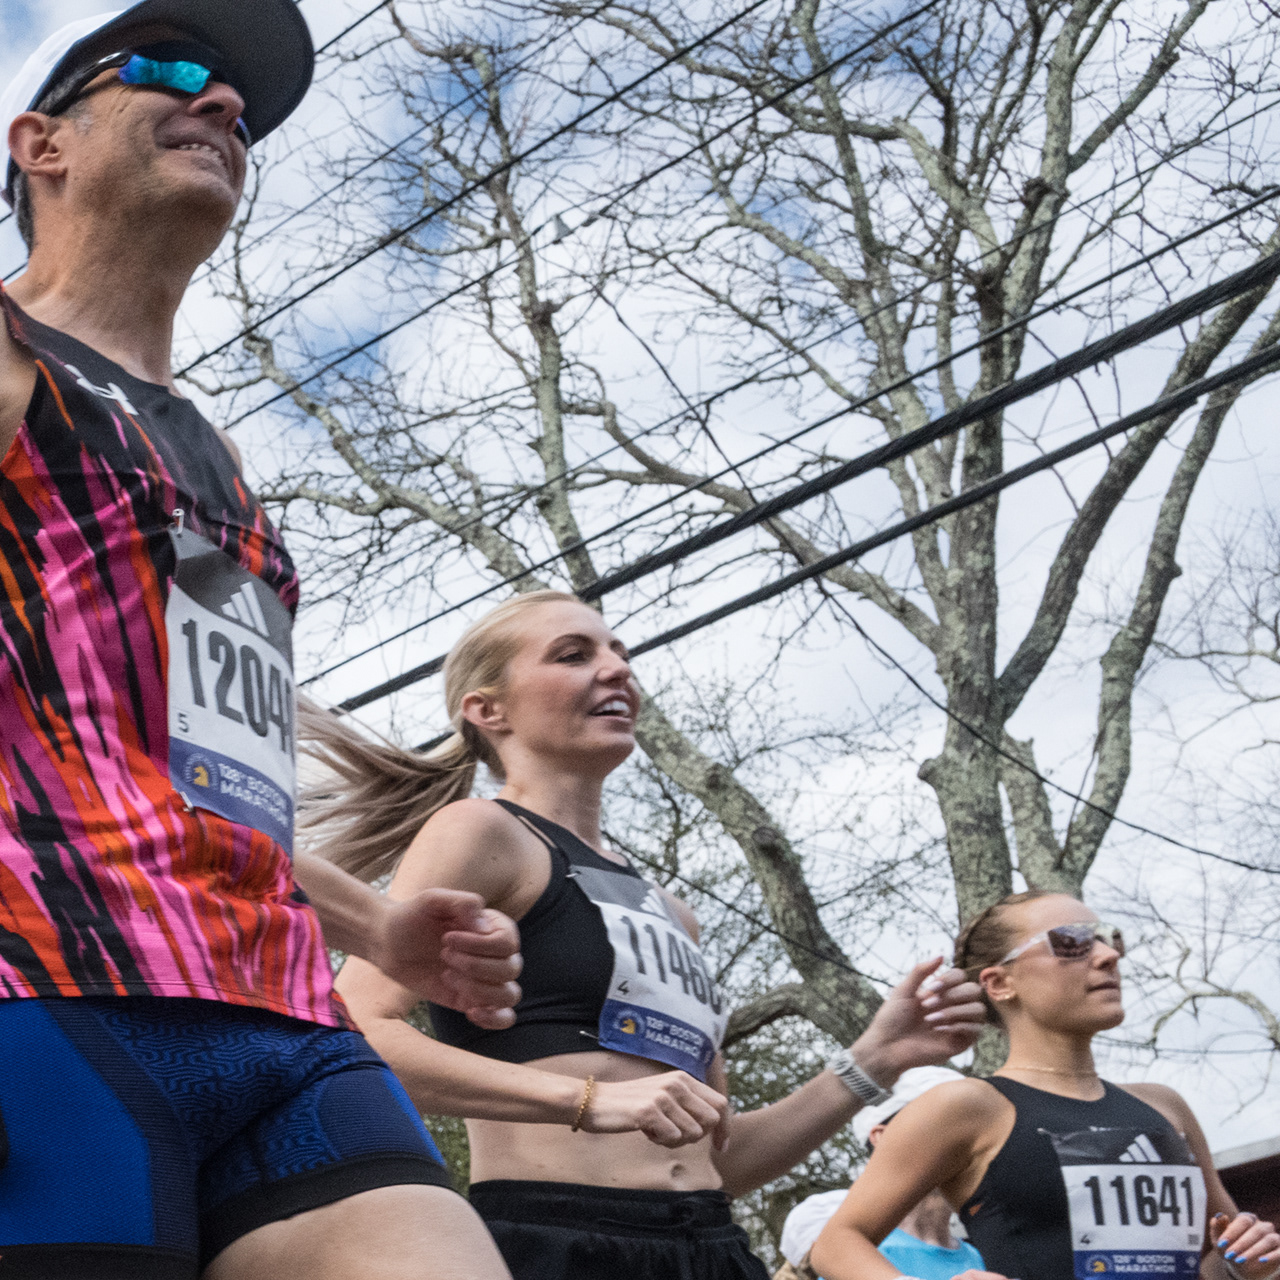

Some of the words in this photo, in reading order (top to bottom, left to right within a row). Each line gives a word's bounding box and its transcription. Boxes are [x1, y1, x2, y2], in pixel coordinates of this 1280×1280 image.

[178, 712, 189, 733] 5
[618, 980, 630, 995] 4
[1084, 1174, 1193, 1227] 11641
[1080, 1234, 1090, 1245] 4
